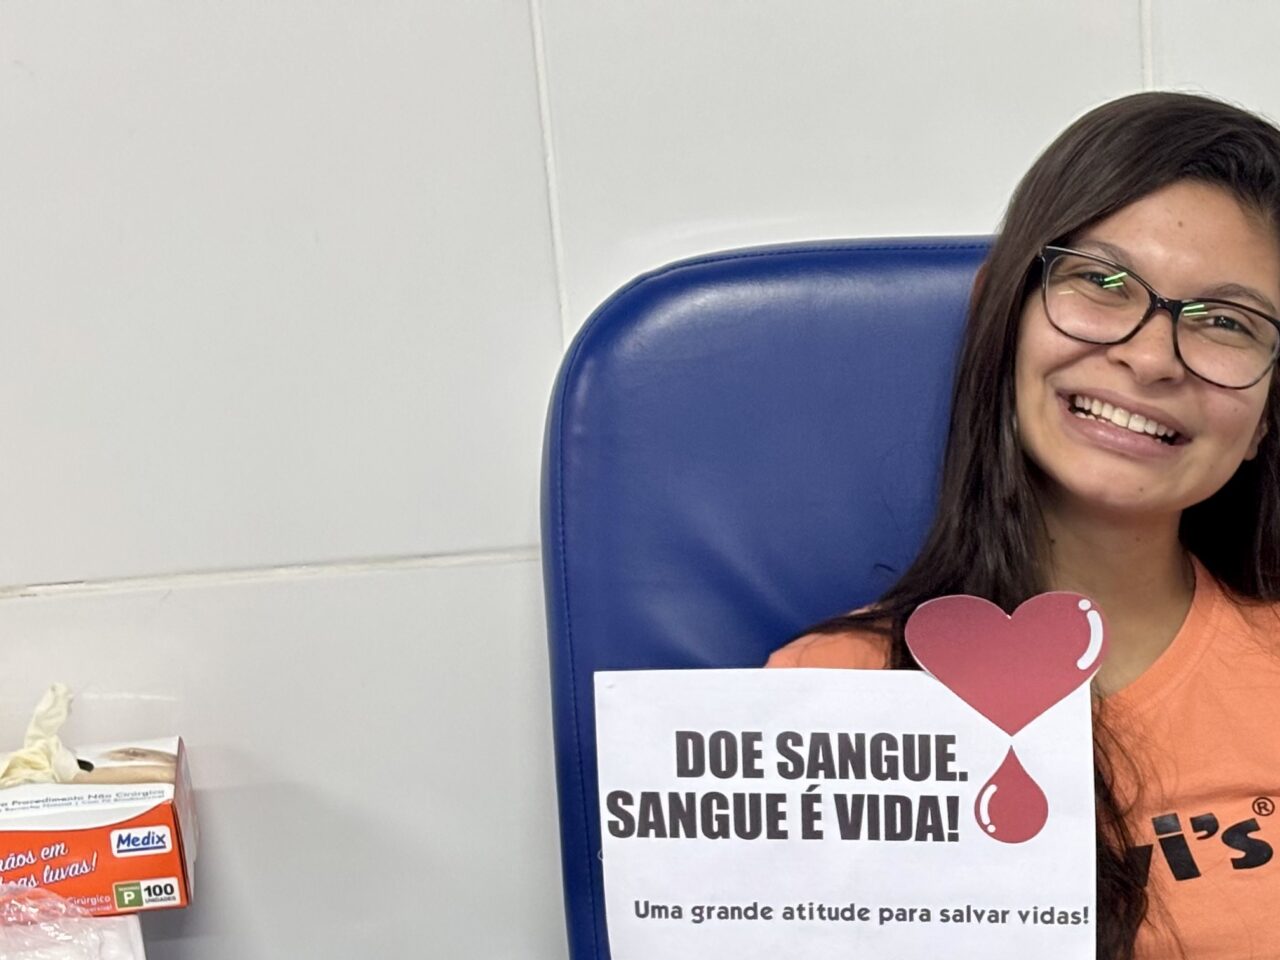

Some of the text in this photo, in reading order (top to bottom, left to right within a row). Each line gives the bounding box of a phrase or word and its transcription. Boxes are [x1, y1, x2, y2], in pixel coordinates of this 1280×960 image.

[675, 730, 969, 782] DOE SANGUE.
[606, 784, 960, 843] SANGUE É VIDA!
[116, 831, 167, 849] Medix
[40, 842, 69, 860] em
[43, 850, 97, 884] luvas!
[123, 891, 136, 905] P
[143, 883, 174, 898] 100
[634, 900, 1090, 925] Uma grande atitude para salvar vidas!
